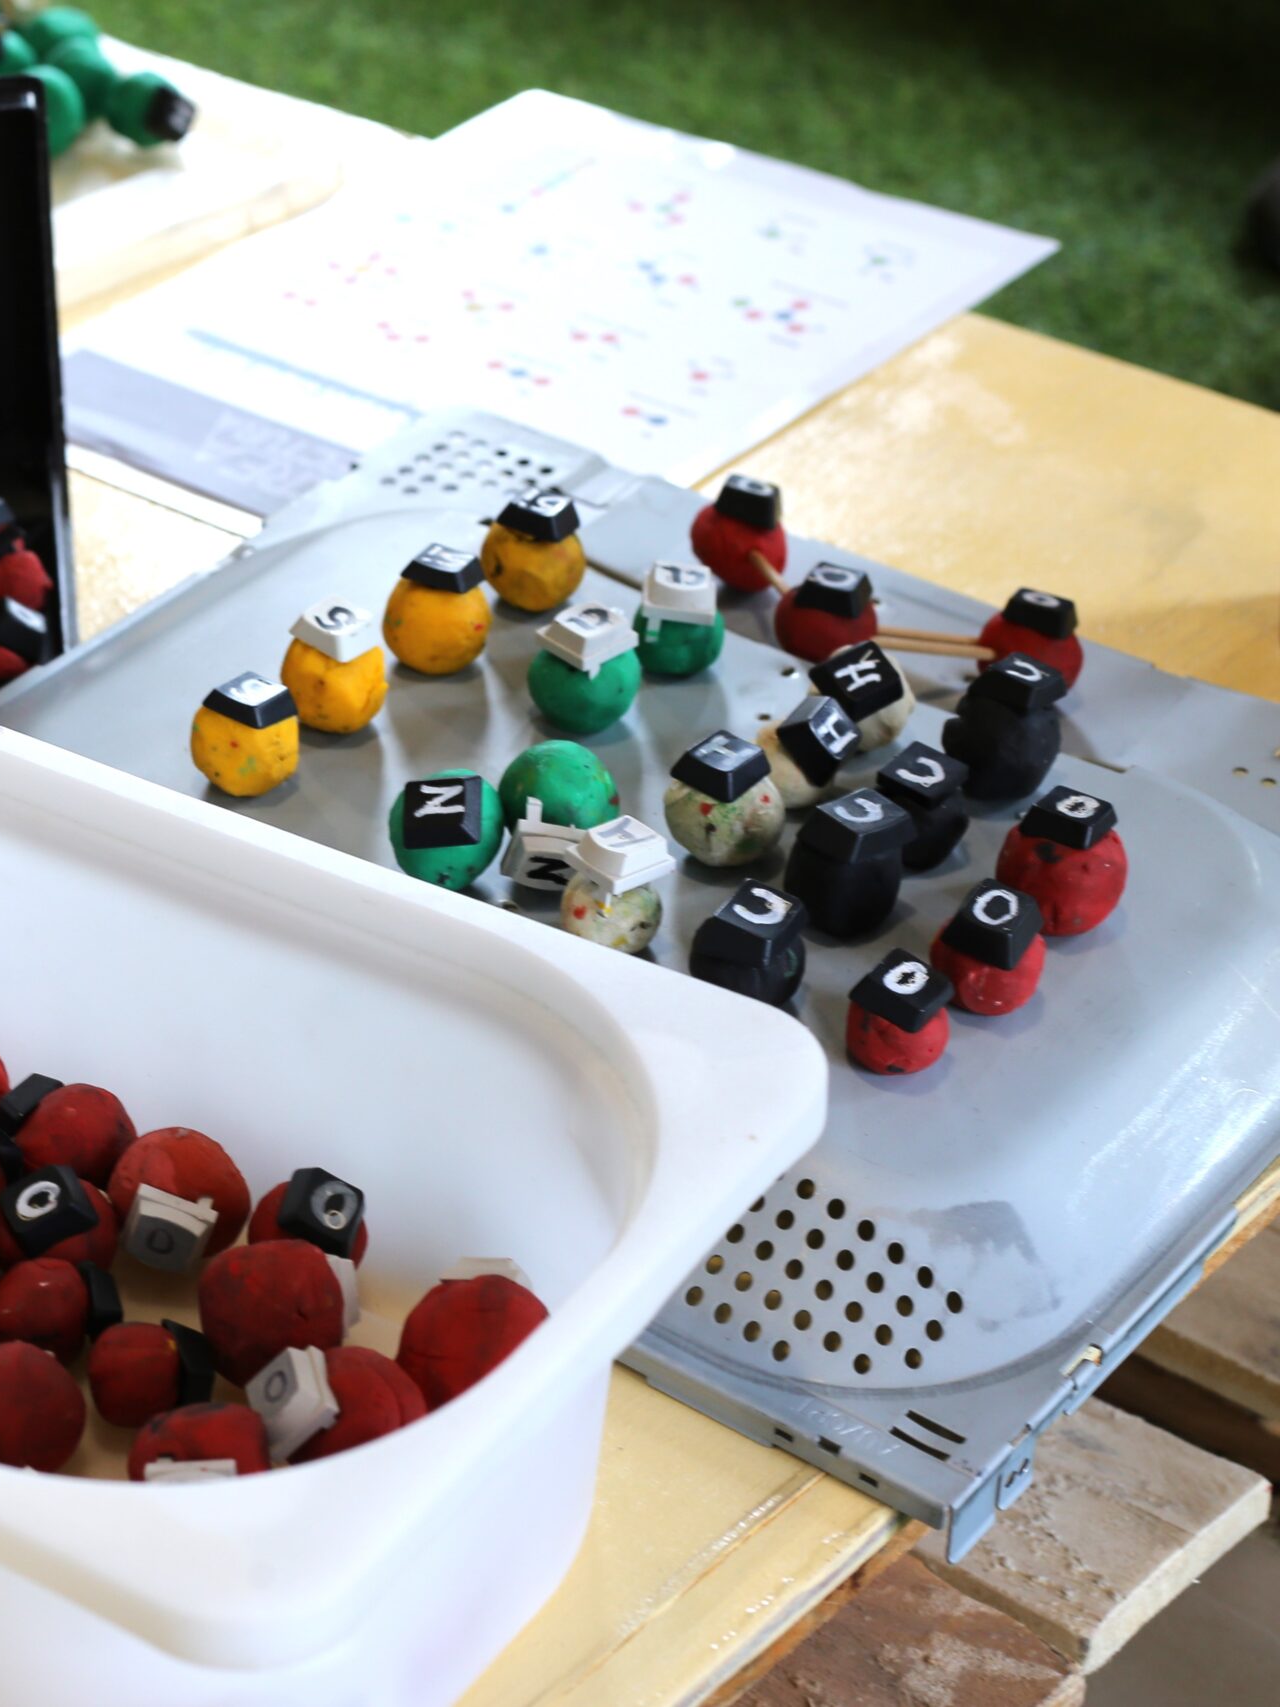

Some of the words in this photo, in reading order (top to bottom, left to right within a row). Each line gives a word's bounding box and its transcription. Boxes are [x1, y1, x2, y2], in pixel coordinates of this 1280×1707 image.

[809, 717, 857, 753] H
[972, 889, 1018, 926] O
[882, 961, 929, 995] O
[16, 1180, 62, 1220] O
[265, 1369, 293, 1401] O
